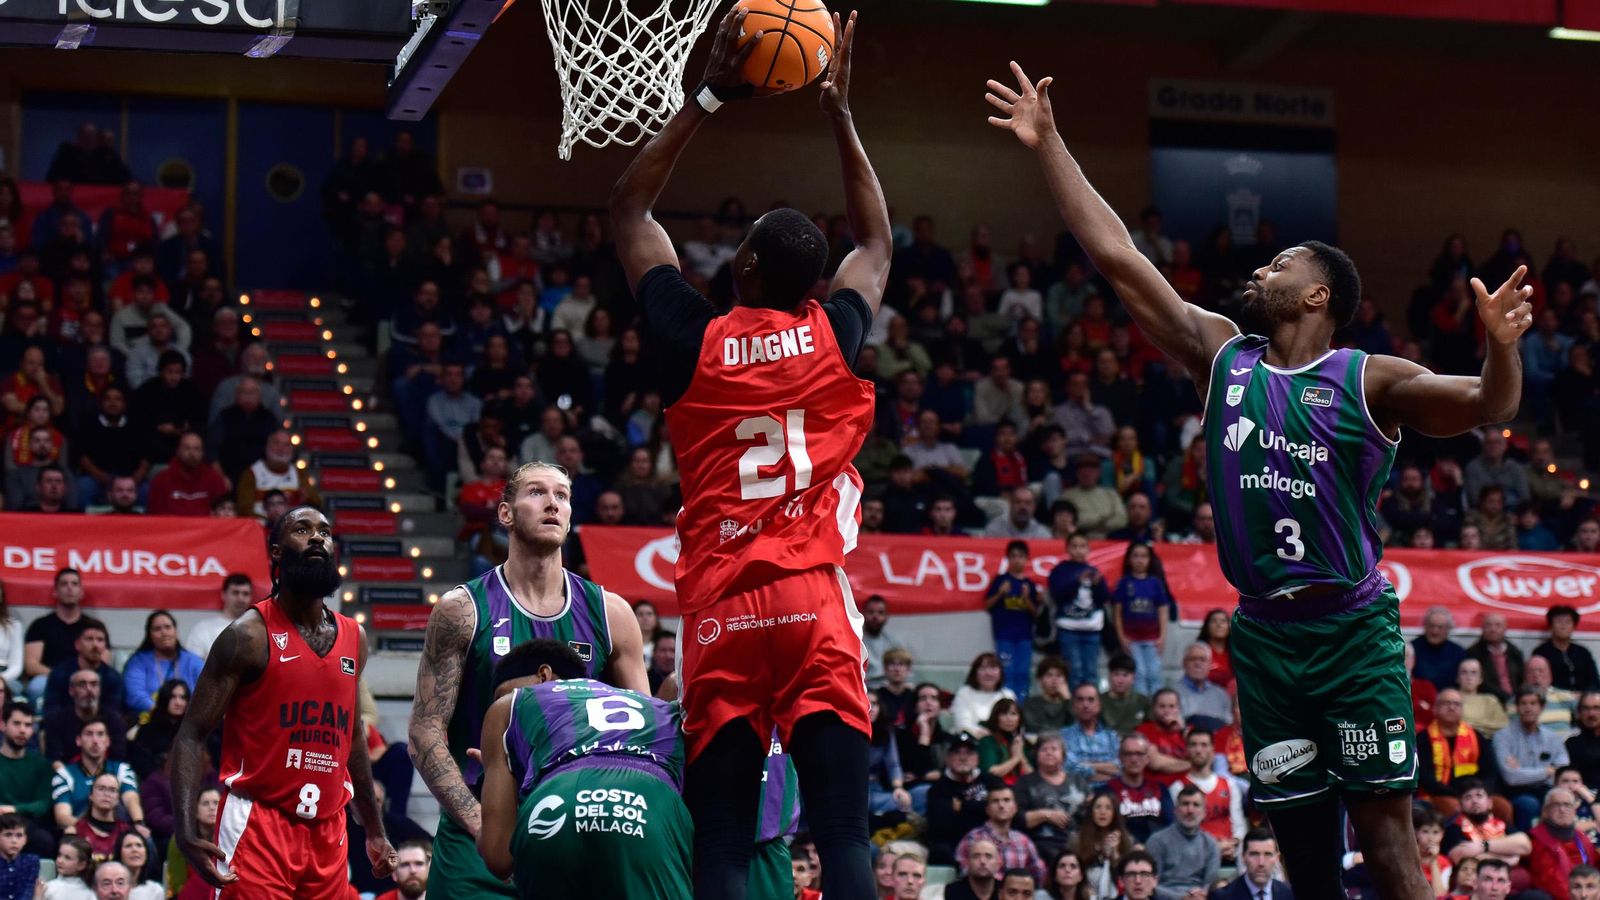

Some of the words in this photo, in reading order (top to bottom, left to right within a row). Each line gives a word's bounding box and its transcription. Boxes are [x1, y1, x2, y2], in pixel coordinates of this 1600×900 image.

[1157, 85, 1243, 113] Grada
[1254, 91, 1326, 119] Norte
[723, 325, 815, 366] DIAGNE
[735, 409, 813, 500] 21
[1259, 429, 1329, 466] Uncaja
[1274, 518, 1305, 562] 3
[3, 546, 56, 571] DE
[67, 549, 227, 576] MURCIA
[1482, 570, 1597, 598] Juver
[727, 619, 763, 632] REGIÓN
[763, 618, 776, 627] DE
[777, 613, 818, 625] MURCIA
[279, 700, 350, 736] UCAM
[586, 695, 646, 731] 6
[1337, 720, 1358, 729] sabor
[289, 729, 341, 748] MURCIA
[1255, 743, 1314, 777] famadesa
[296, 782, 321, 819] 8
[575, 804, 609, 818] DEL
[612, 804, 647, 824] SOL
[576, 788, 648, 811] COSTA
[575, 817, 645, 839] MÁLAGA
